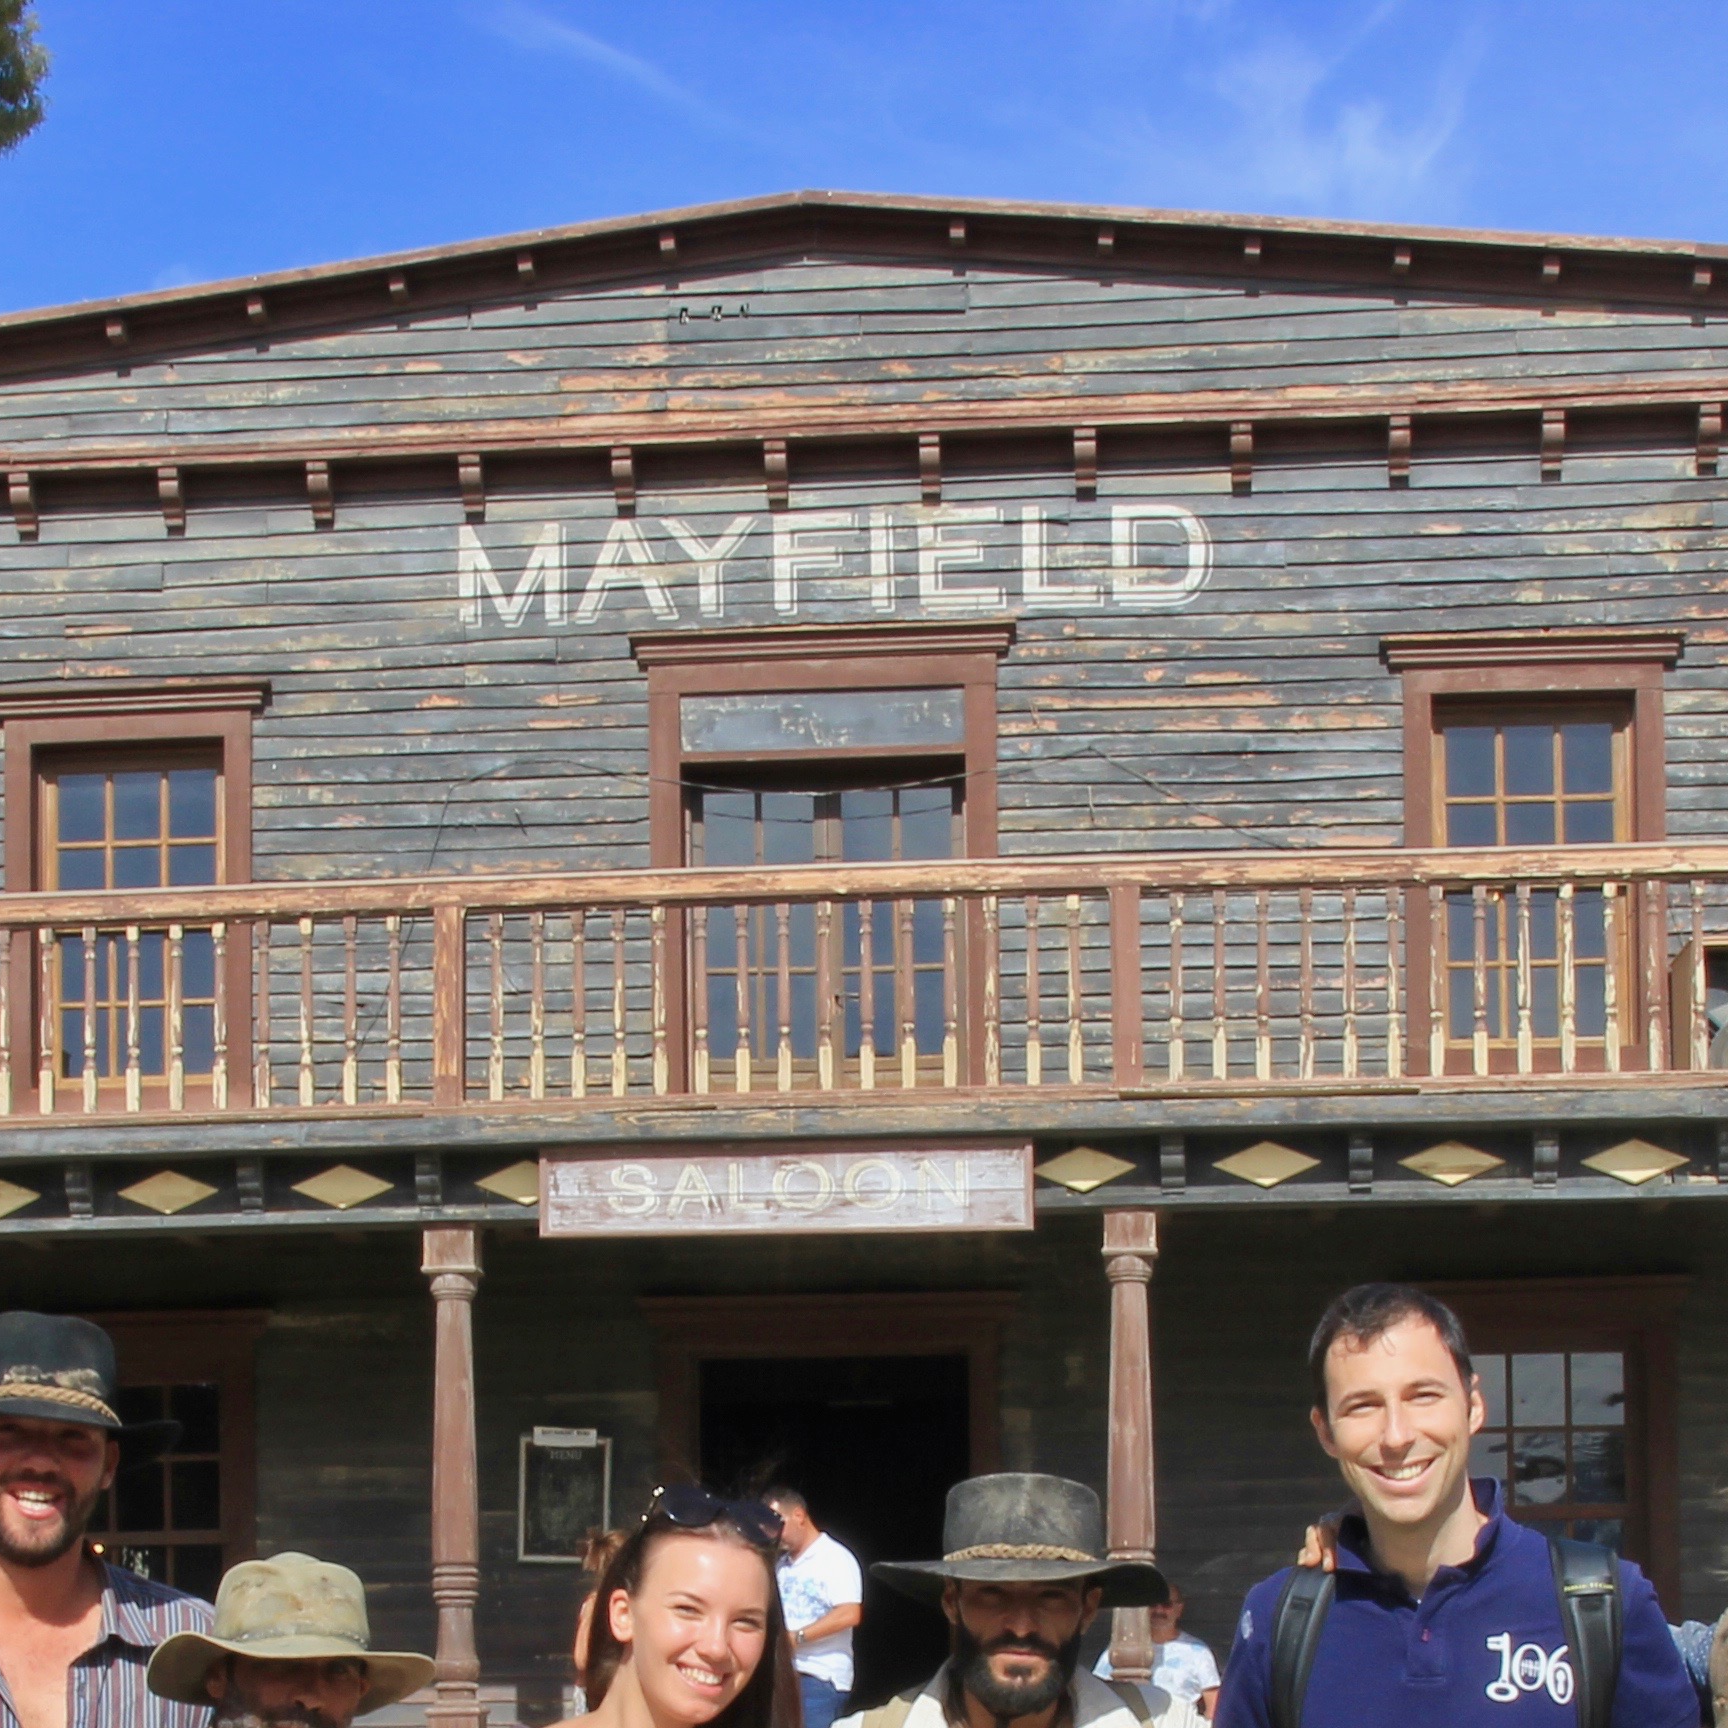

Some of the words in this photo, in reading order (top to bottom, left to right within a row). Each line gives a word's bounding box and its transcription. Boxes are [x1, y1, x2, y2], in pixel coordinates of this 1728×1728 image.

[458, 505, 1214, 628] MAYFIELD
[608, 1158, 970, 1216] SALOON
[1486, 1631, 1575, 1705] 106
